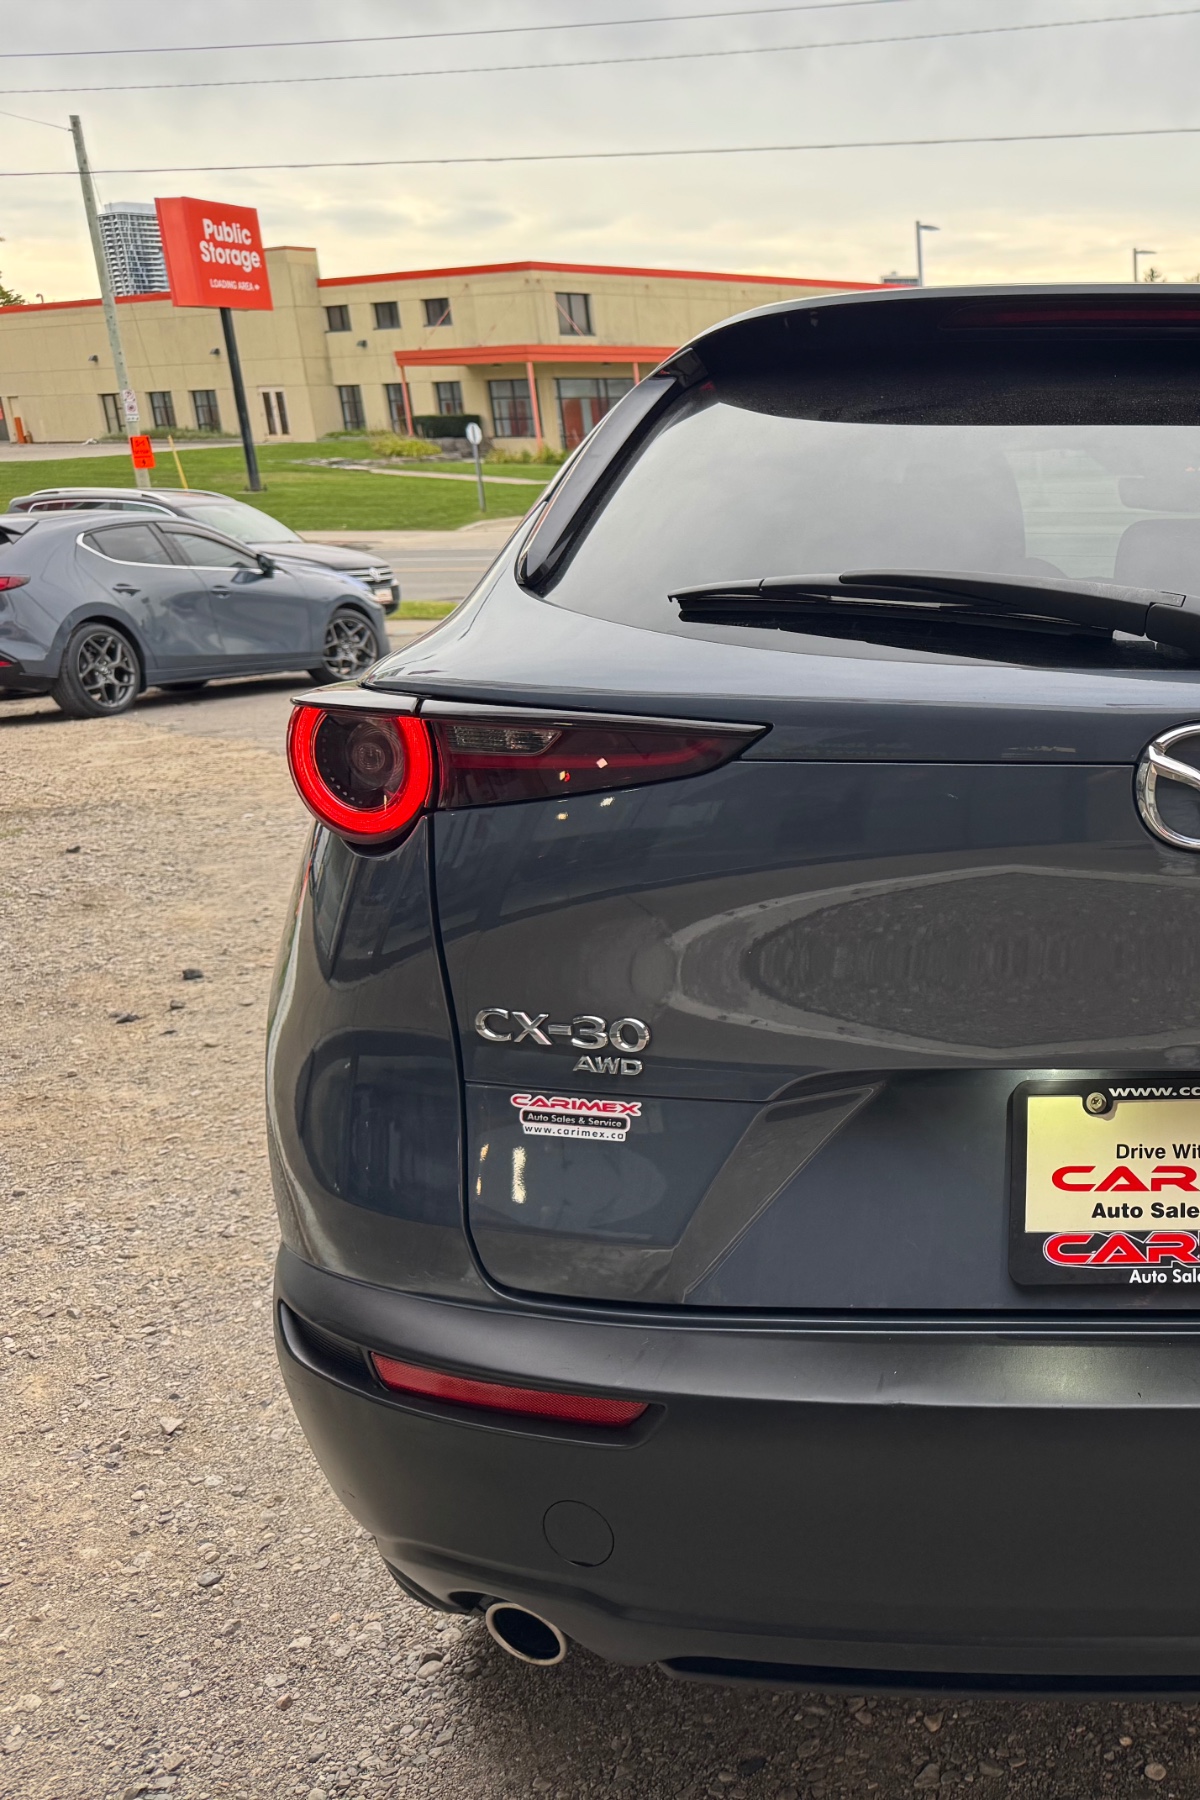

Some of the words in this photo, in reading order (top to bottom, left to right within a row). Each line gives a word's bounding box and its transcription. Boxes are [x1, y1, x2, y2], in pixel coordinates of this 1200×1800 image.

[202, 218, 252, 246] Public
[200, 240, 260, 273] Storage
[475, 1007, 650, 1053] CX-30
[572, 1055, 643, 1076] AWD
[510, 1095, 641, 1116] CARIMEX
[527, 1112, 549, 1122] Auto
[551, 1114, 576, 1125] Sales
[578, 1116, 586, 1126] &
[588, 1118, 622, 1128] Service
[524, 1125, 624, 1141] www.carimex.ca
[1116, 1143, 1166, 1160] Drive
[1091, 1202, 1144, 1219] Auto
[1129, 1269, 1168, 1284] Auto
